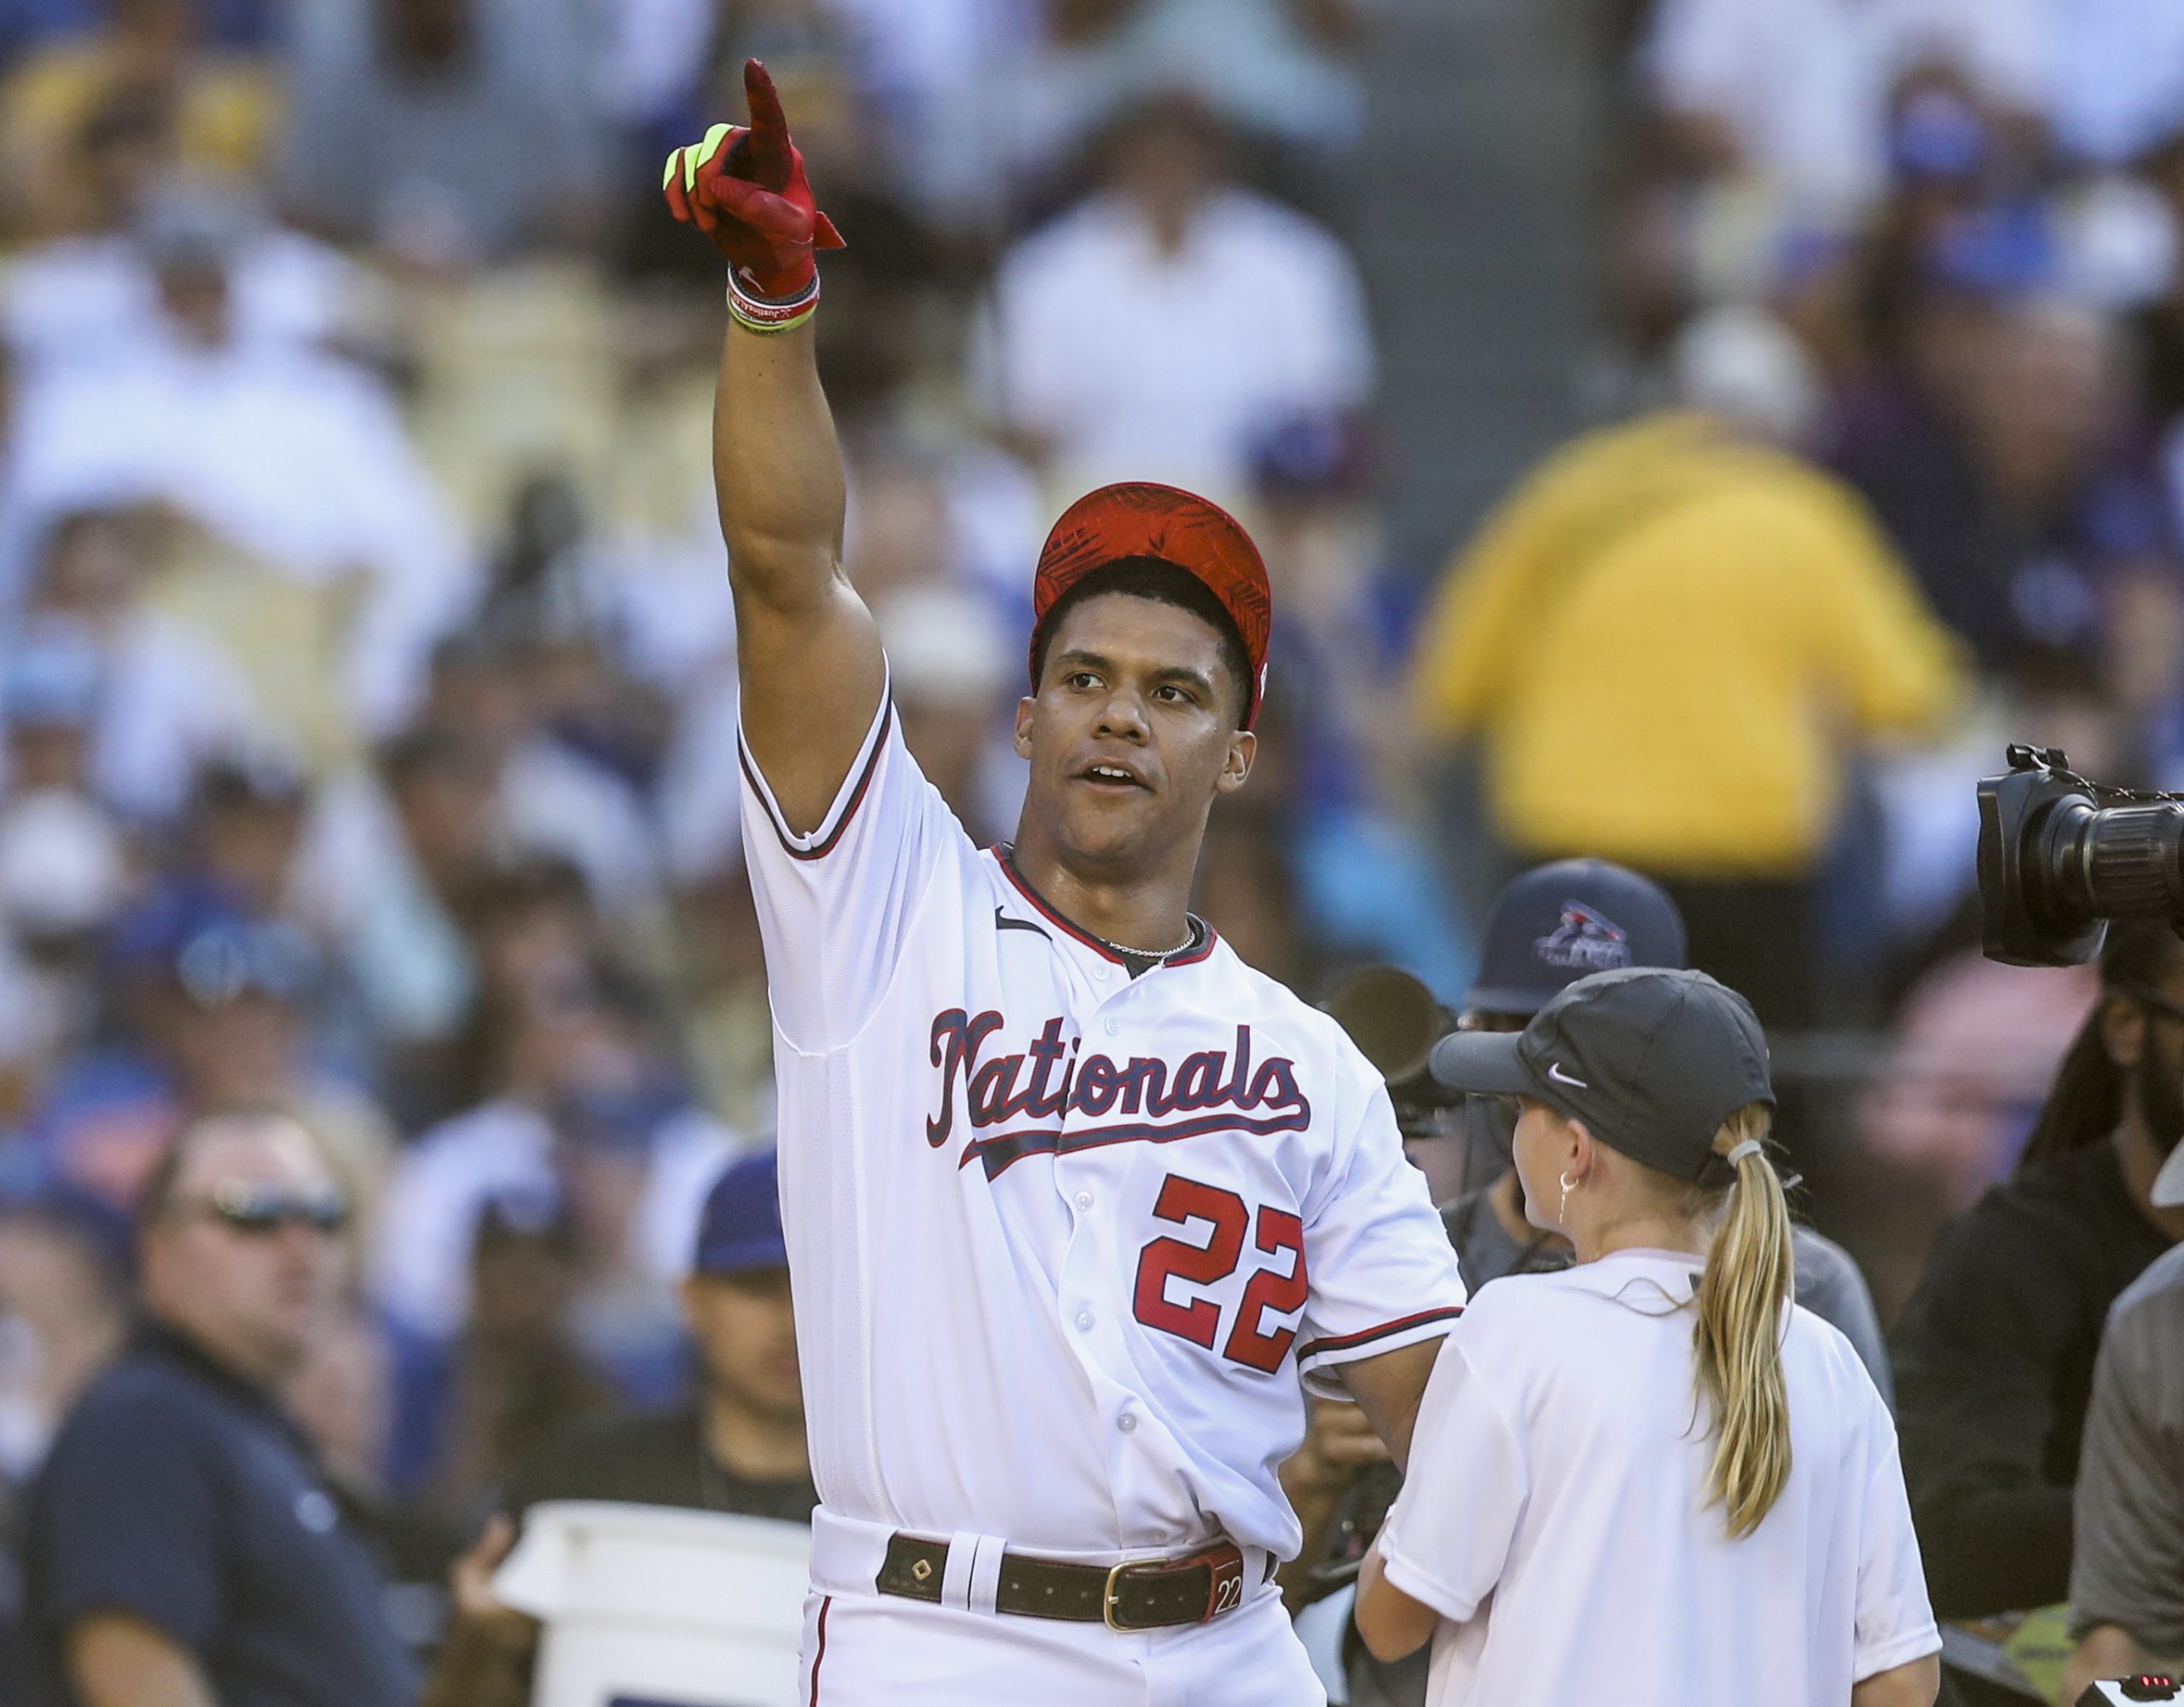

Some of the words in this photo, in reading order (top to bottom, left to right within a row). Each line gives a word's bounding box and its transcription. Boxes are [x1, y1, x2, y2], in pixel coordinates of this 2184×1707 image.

[926, 1007, 1310, 1148] Nationals
[1132, 1172, 1309, 1375] 22
[1214, 1575, 1242, 1614] 22
